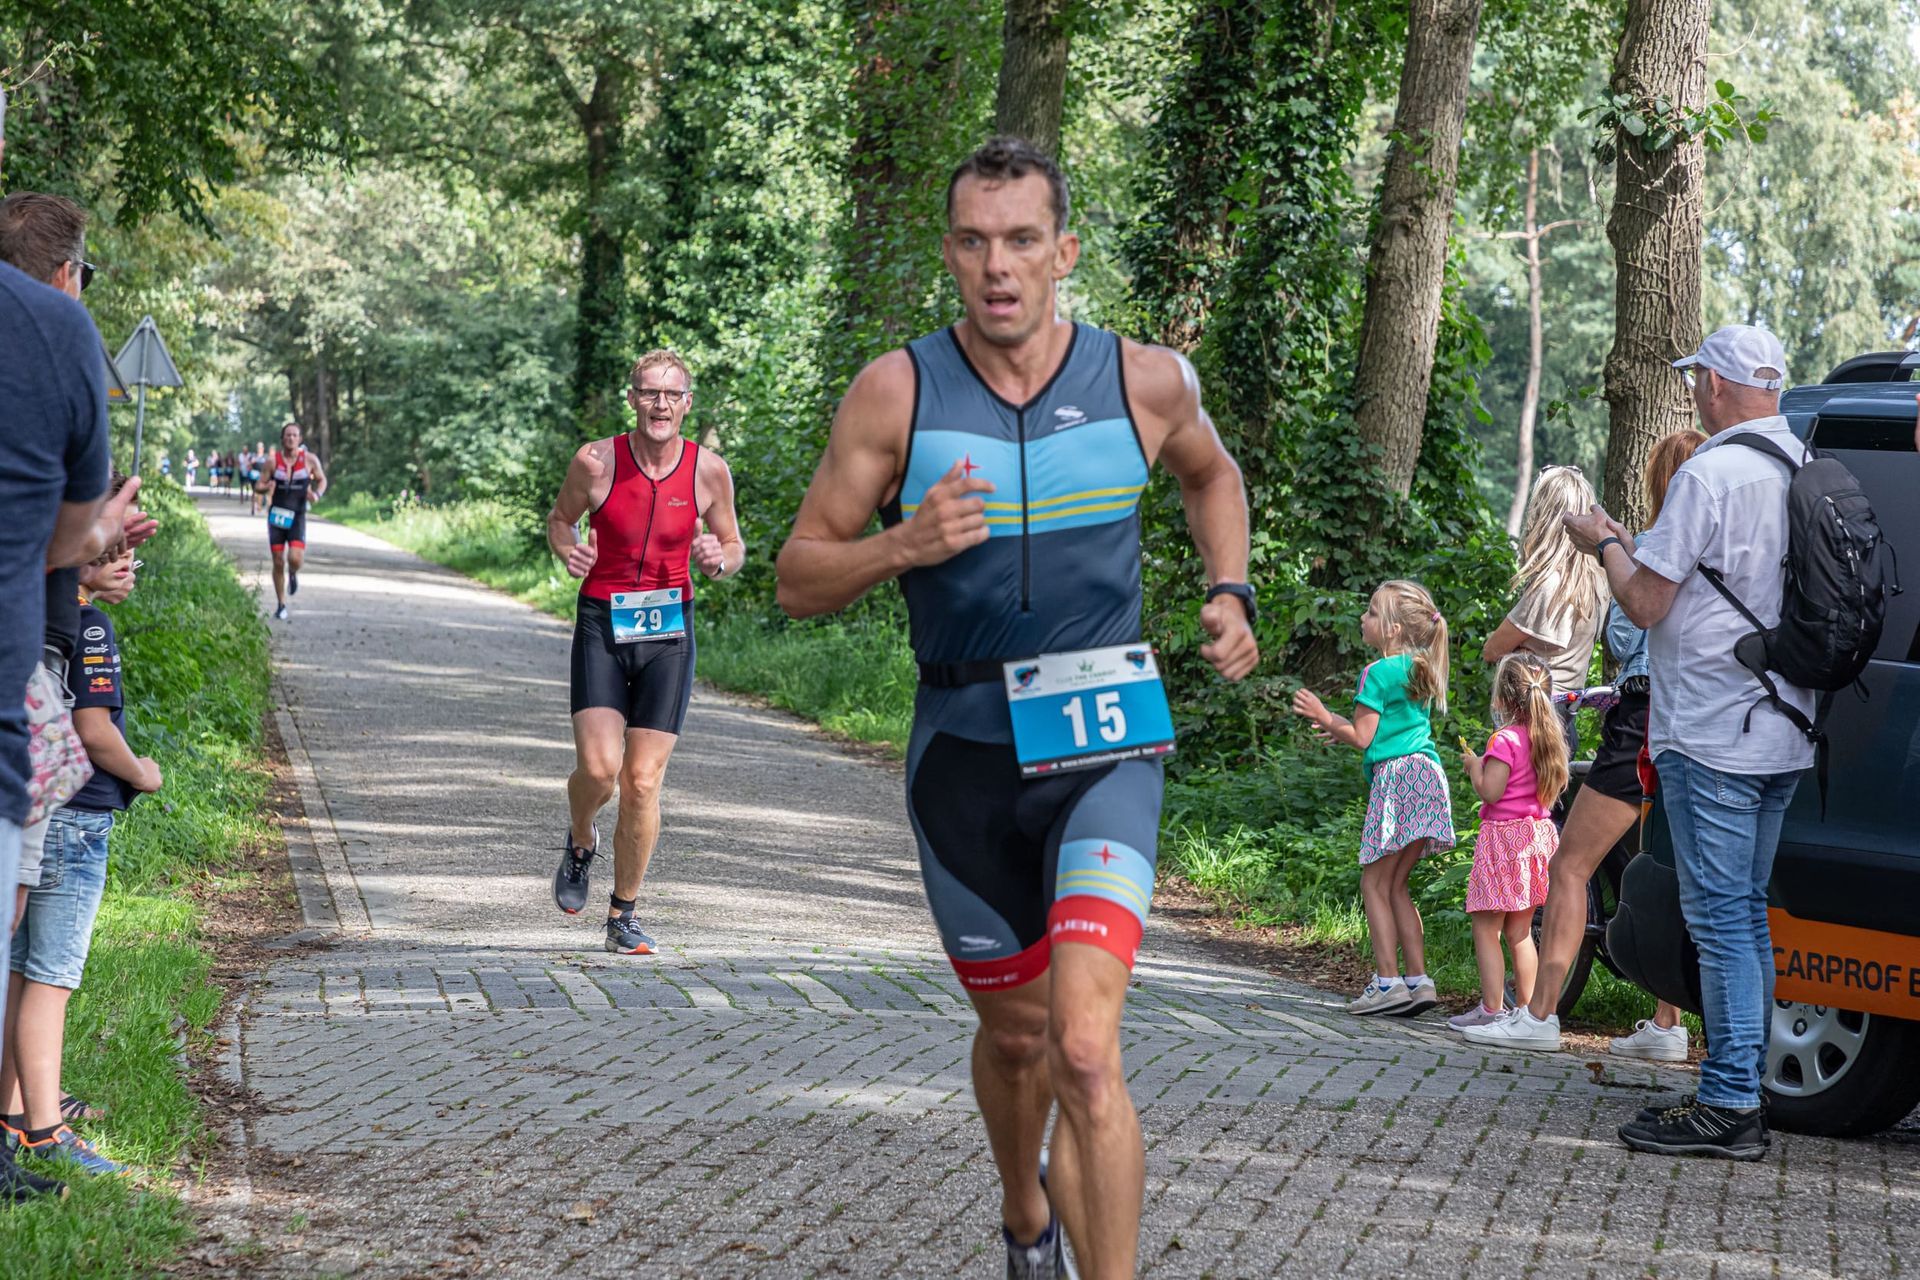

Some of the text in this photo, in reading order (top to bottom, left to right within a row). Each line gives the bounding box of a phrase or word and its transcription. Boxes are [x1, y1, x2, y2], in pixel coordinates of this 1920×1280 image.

[634, 609, 662, 632] 29
[1062, 690, 1128, 748] 15
[1773, 946, 1903, 994] CARPROF
